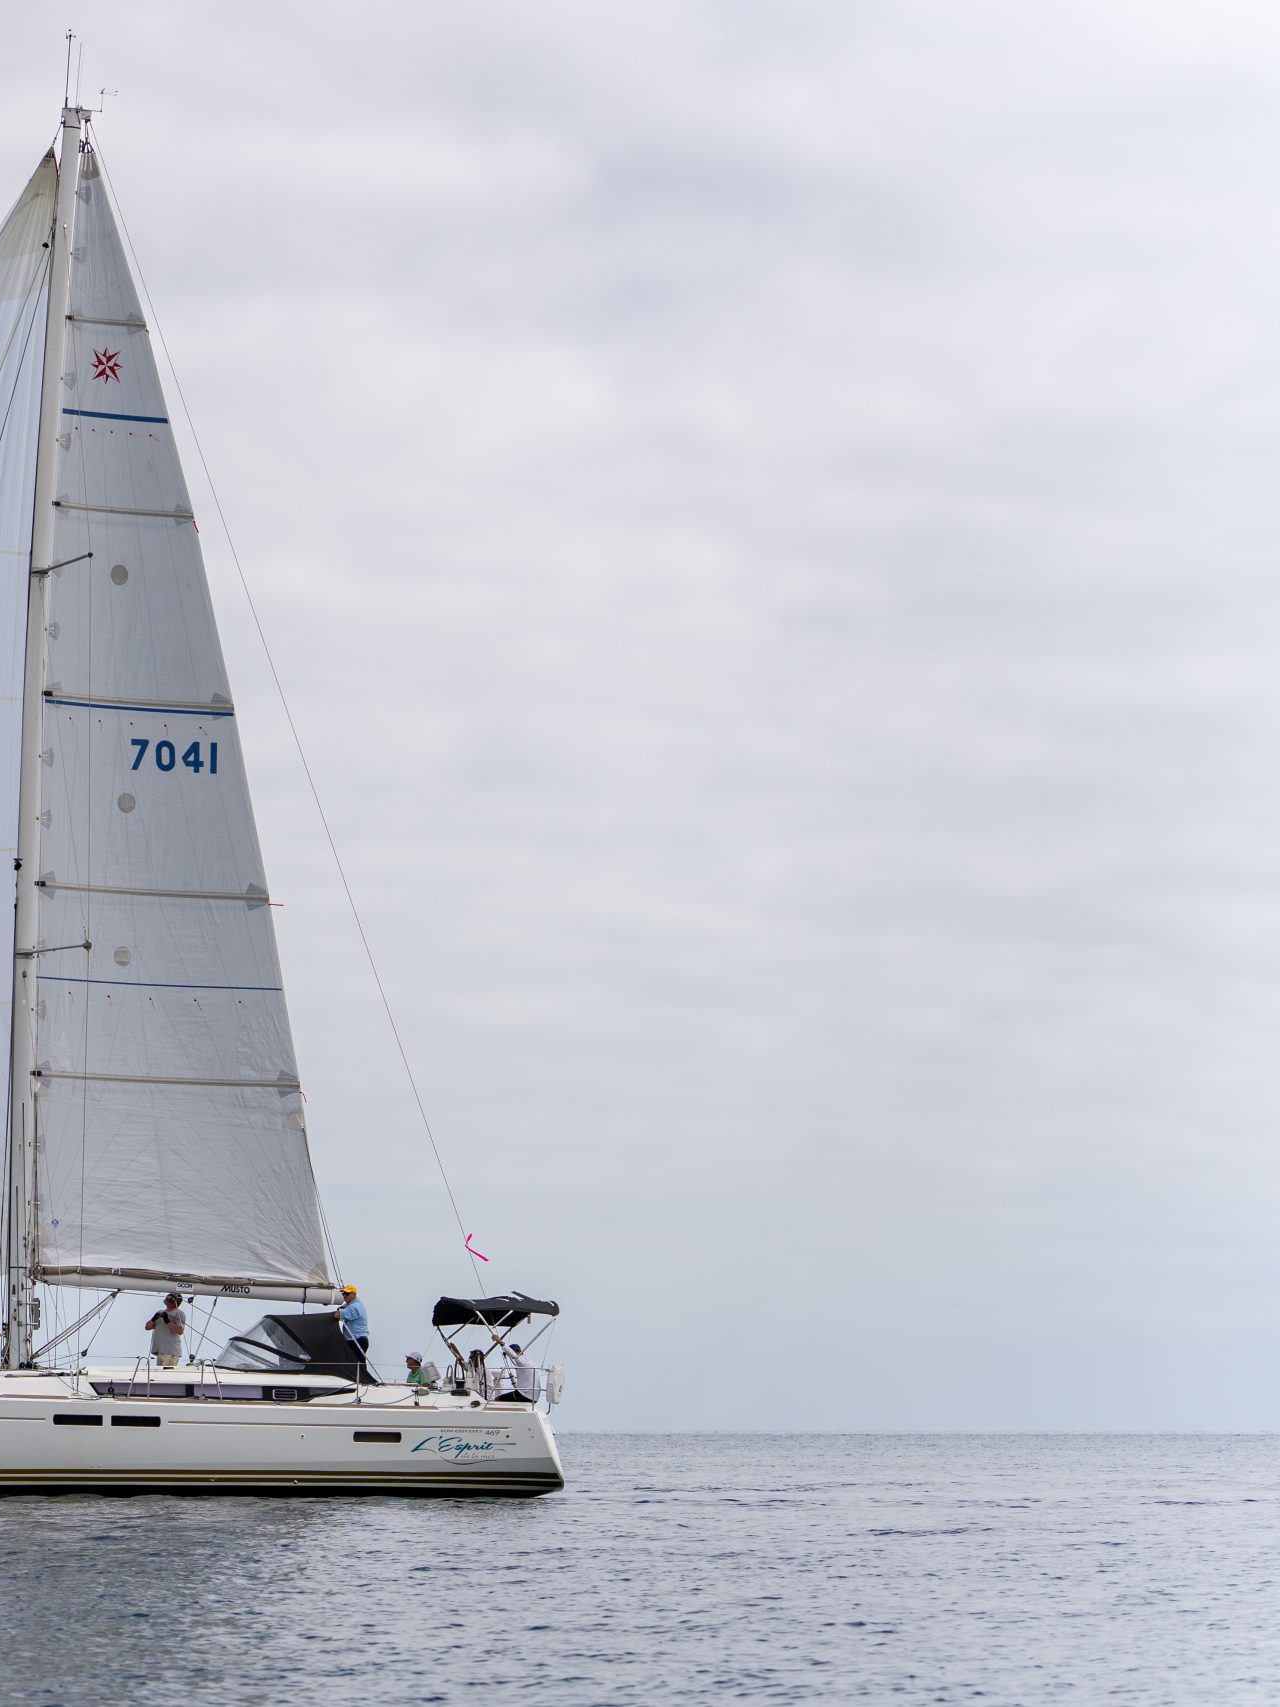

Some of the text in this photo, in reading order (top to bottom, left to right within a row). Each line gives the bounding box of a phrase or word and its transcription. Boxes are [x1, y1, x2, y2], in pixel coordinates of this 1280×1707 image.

[130, 738, 218, 774] 7041
[220, 1285, 251, 1294] MUSTO
[410, 1435, 516, 1459] L'Esprit
